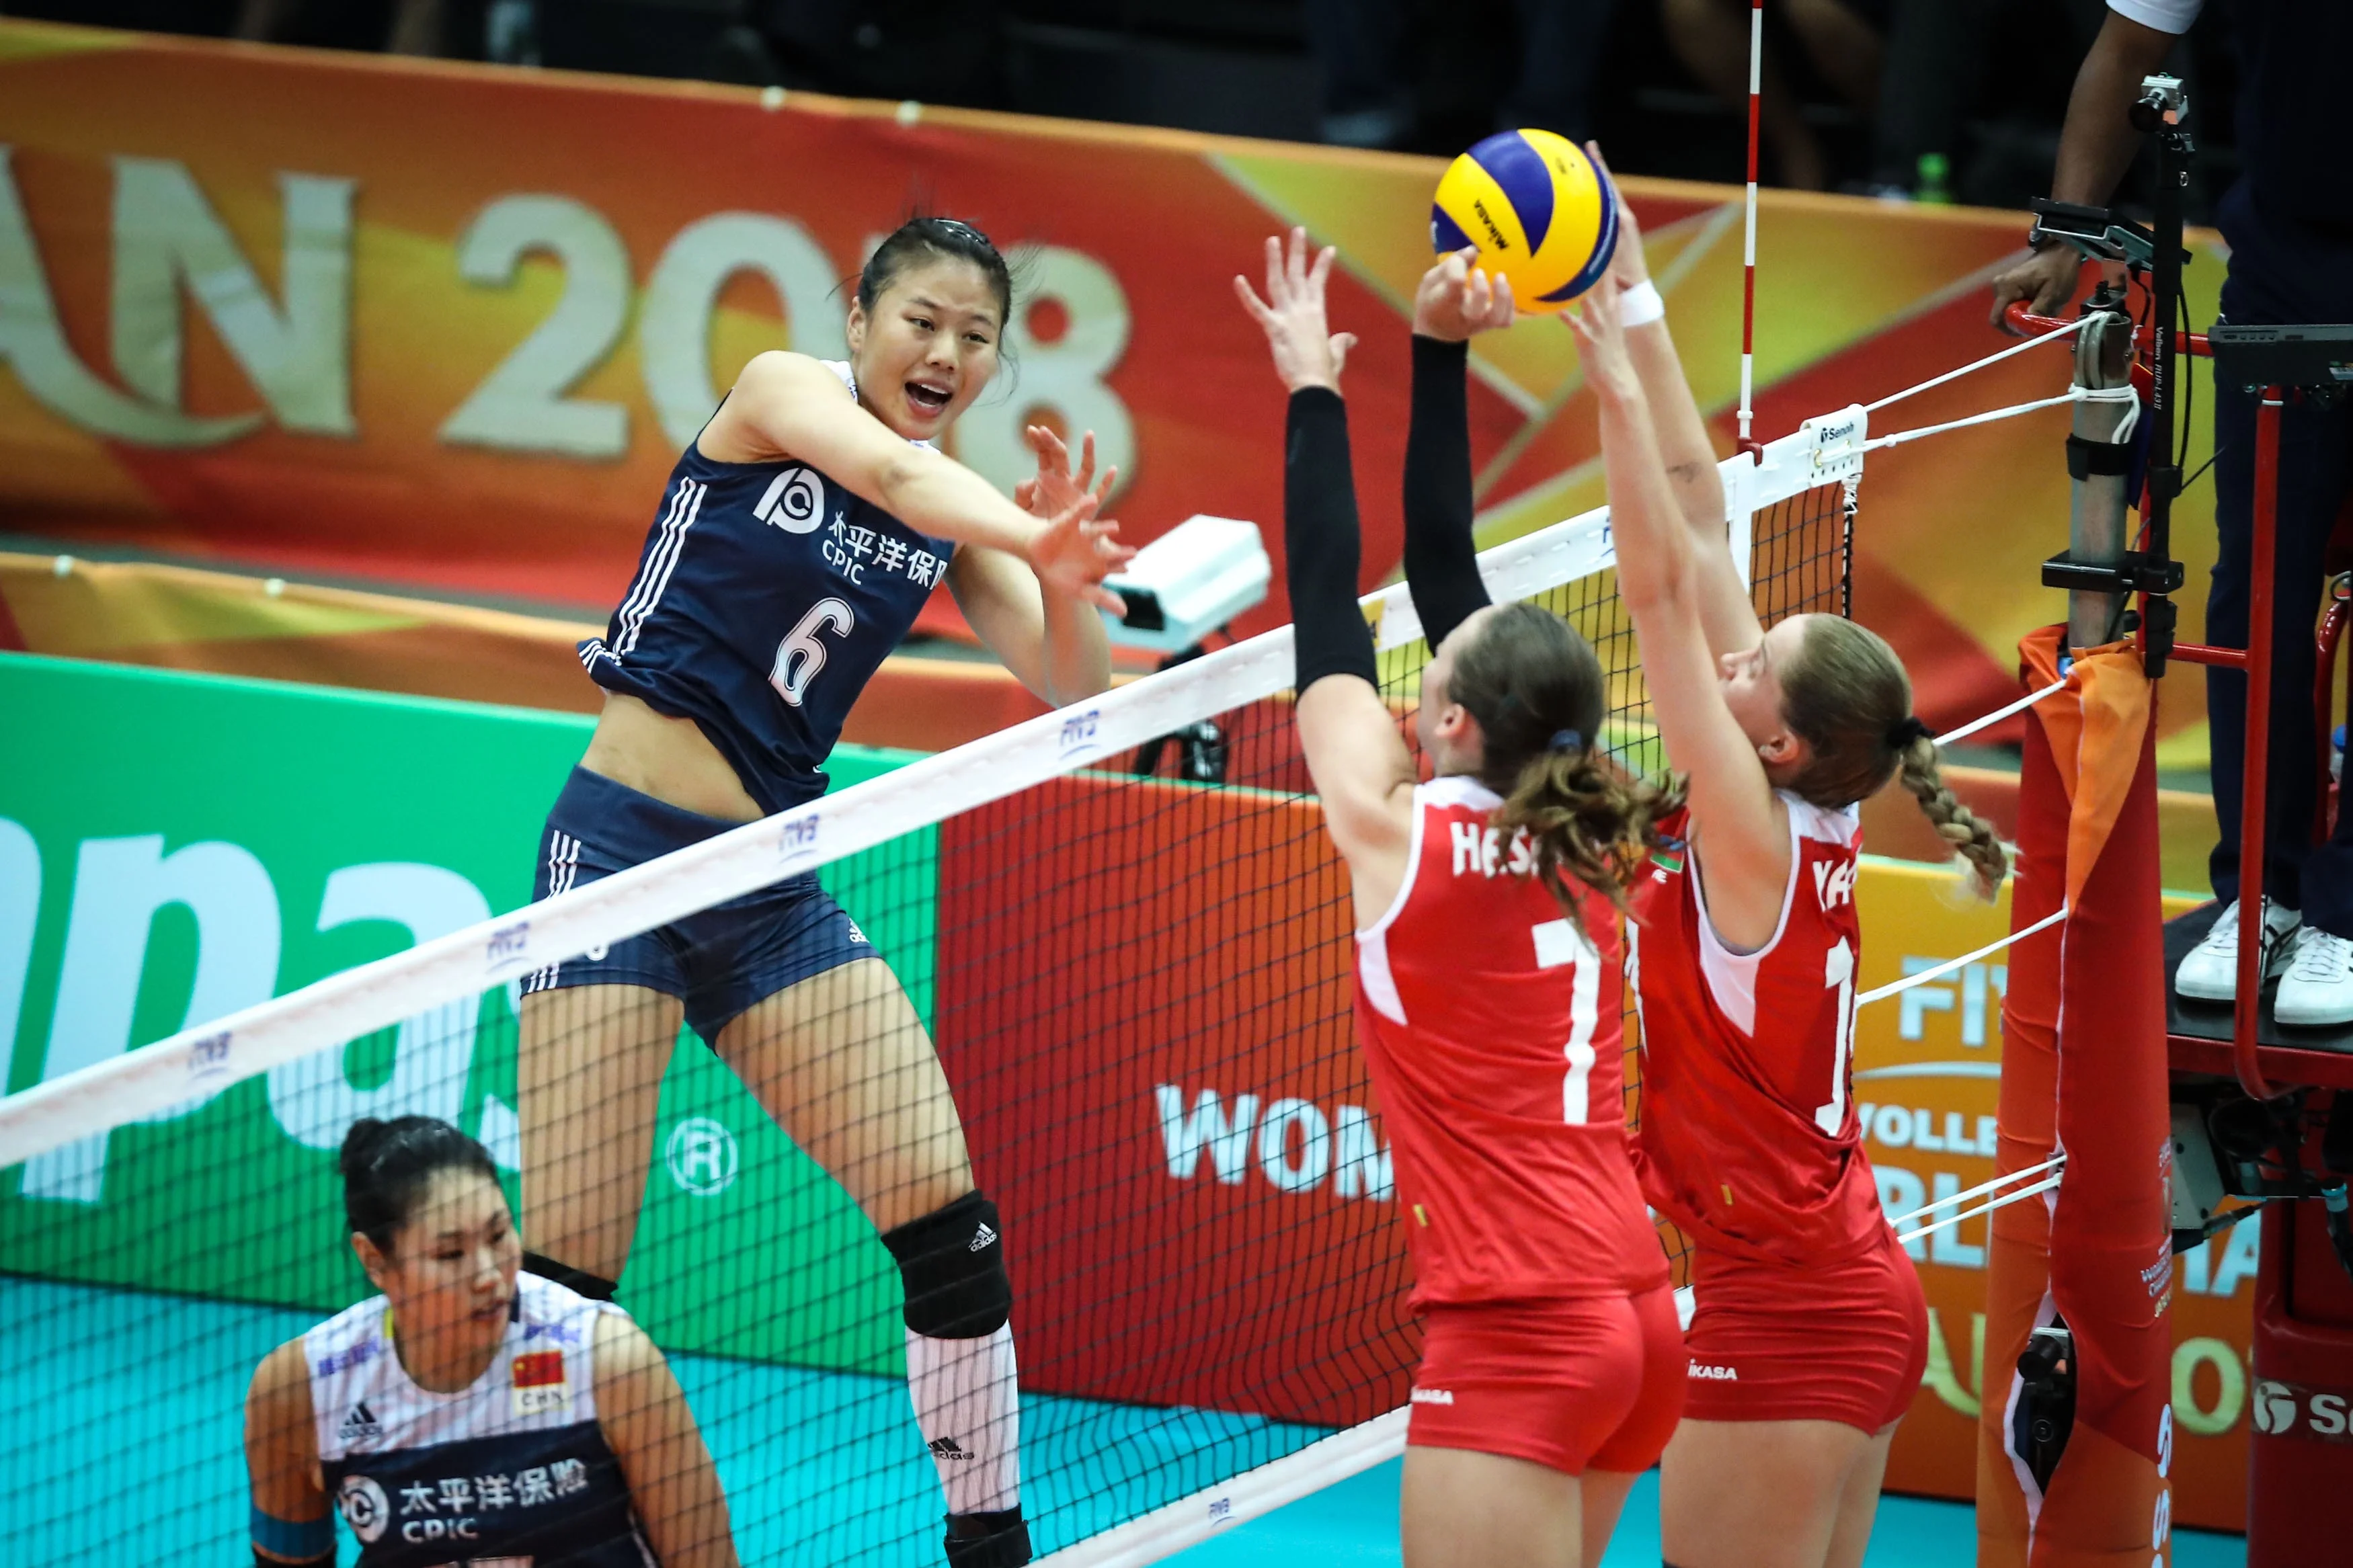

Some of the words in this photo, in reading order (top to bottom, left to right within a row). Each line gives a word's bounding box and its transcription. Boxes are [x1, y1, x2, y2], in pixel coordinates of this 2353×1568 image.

[436, 190, 1136, 501] 208
[822, 539, 865, 585] CPIC
[768, 596, 854, 708] 6
[1532, 918, 1601, 1125] 7
[399, 1457, 589, 1516] 太平洋保险
[401, 1517, 479, 1544] CPIC
